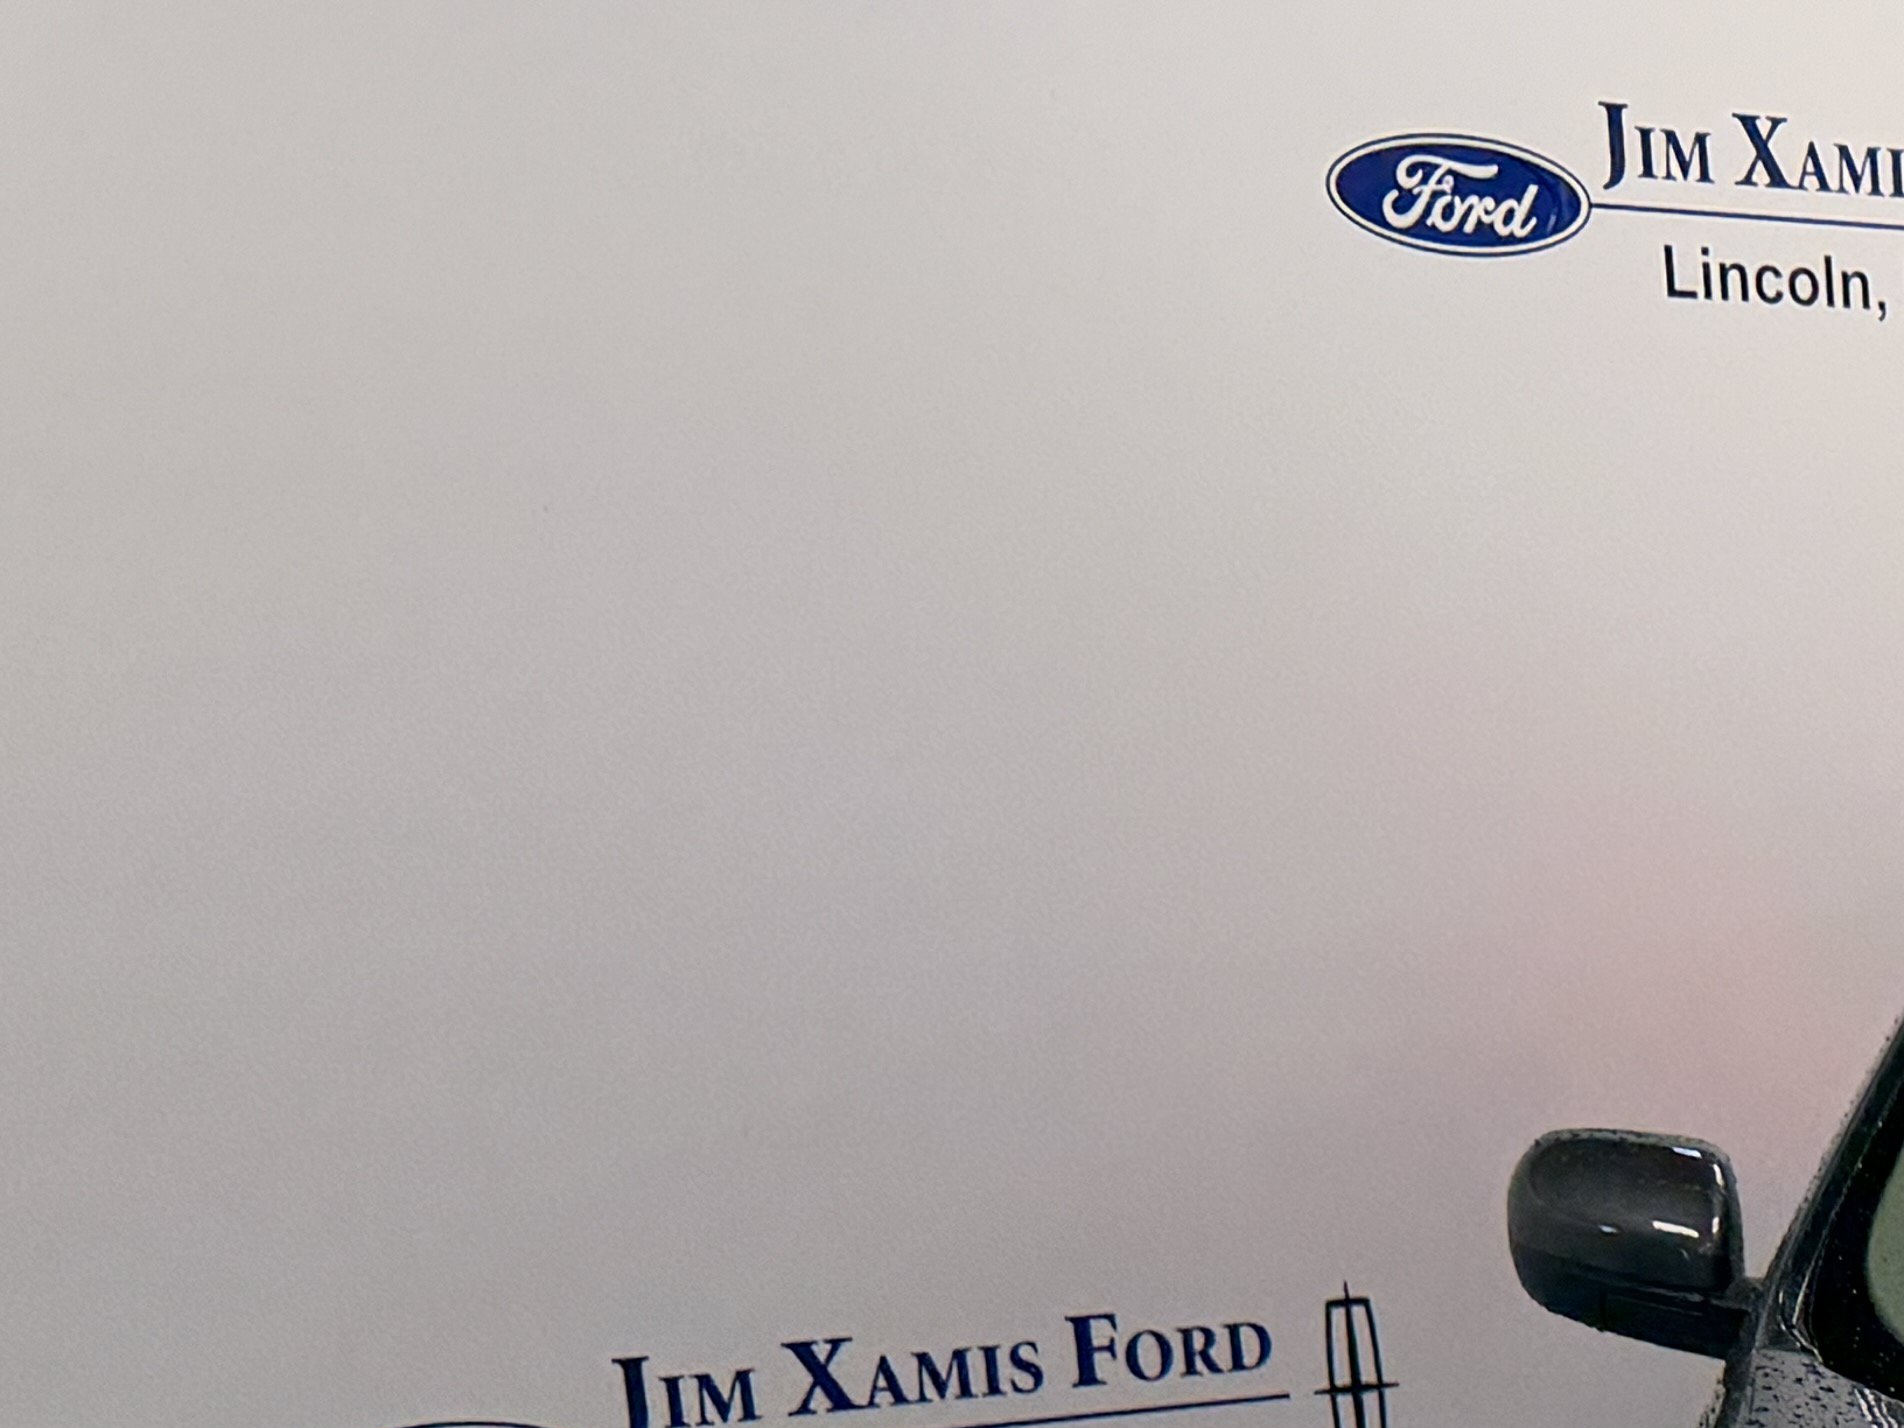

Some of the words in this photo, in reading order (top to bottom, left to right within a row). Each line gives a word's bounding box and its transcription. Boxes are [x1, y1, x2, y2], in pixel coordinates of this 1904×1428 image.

[1596, 101, 1712, 190] JIM
[1382, 154, 1538, 240] Ford
[1663, 244, 1888, 321] Lincoln,
[781, 1337, 1045, 1416] XAMIS
[1065, 1311, 1273, 1389] FORD
